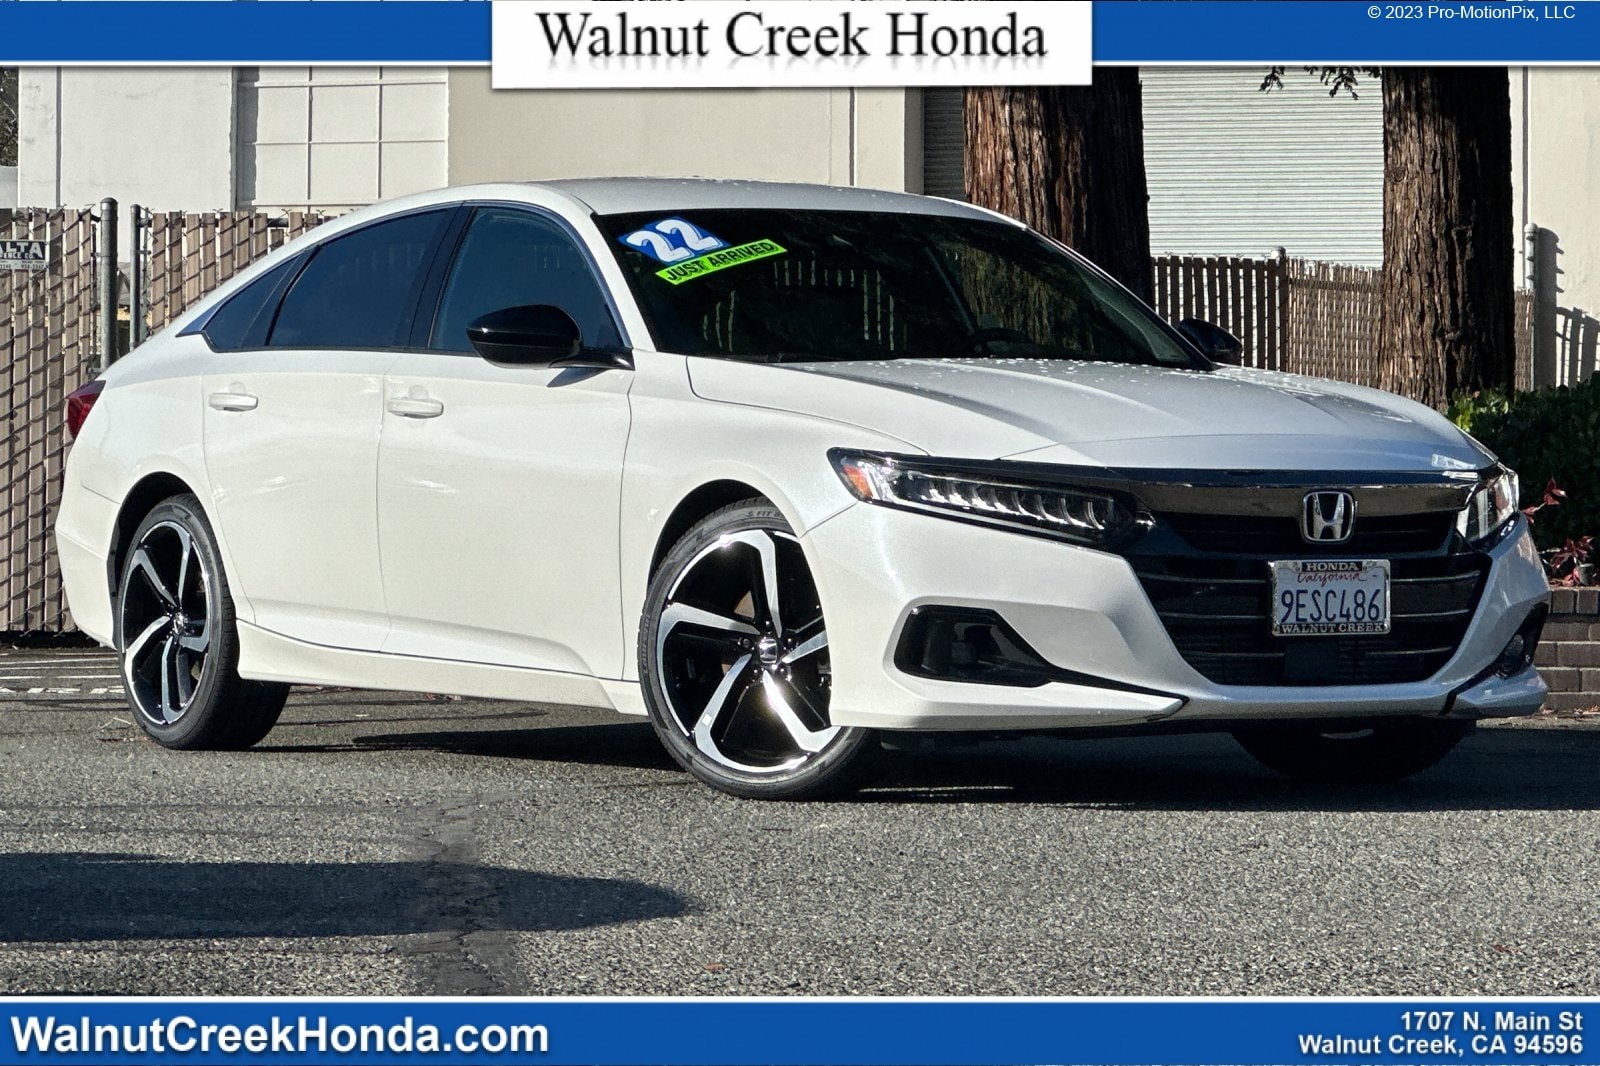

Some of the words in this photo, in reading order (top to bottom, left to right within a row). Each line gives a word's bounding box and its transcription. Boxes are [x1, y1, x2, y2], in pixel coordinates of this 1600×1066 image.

[626, 219, 724, 263] 22
[665, 260, 705, 281] JUST
[706, 241, 776, 268] ARRIVED
[1297, 571, 1362, 587] California
[1306, 562, 1358, 572] HONDA
[1280, 588, 1381, 623] 9ESC486
[1281, 624, 1336, 634] WALNUT
[1338, 623, 1383, 633] CREEK
